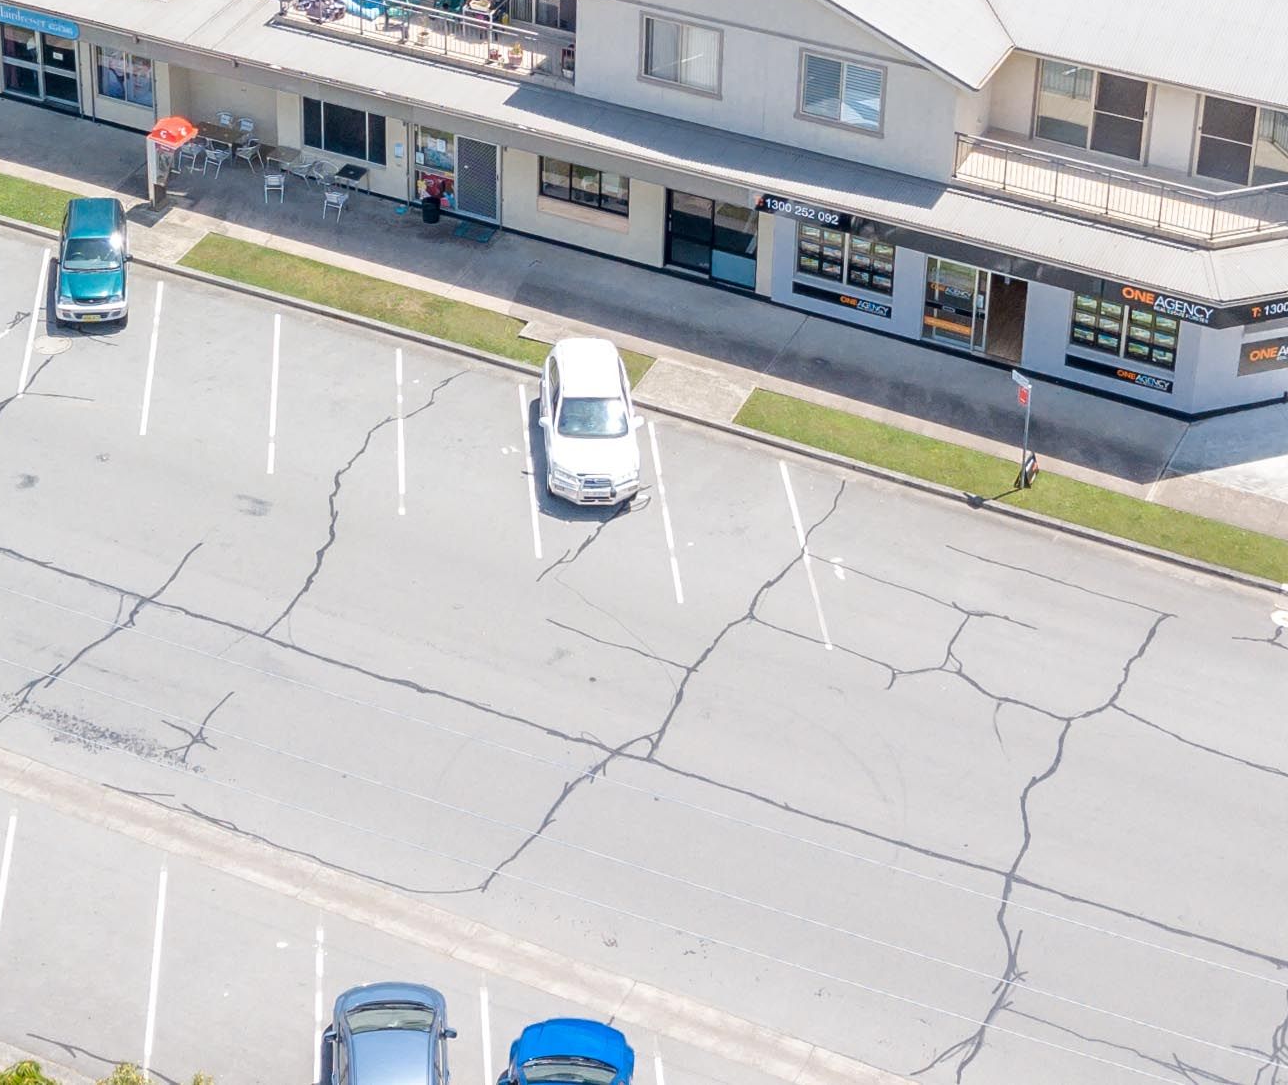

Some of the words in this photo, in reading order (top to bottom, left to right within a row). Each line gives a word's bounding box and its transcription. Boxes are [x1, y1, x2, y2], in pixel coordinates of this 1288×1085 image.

[765, 198, 792, 213] 1300
[794, 205, 815, 219] 252
[817, 211, 839, 225] 092
[1122, 286, 1155, 305] ONE
[1154, 295, 1214, 319] AGENCY
[1249, 346, 1279, 362] ONE
